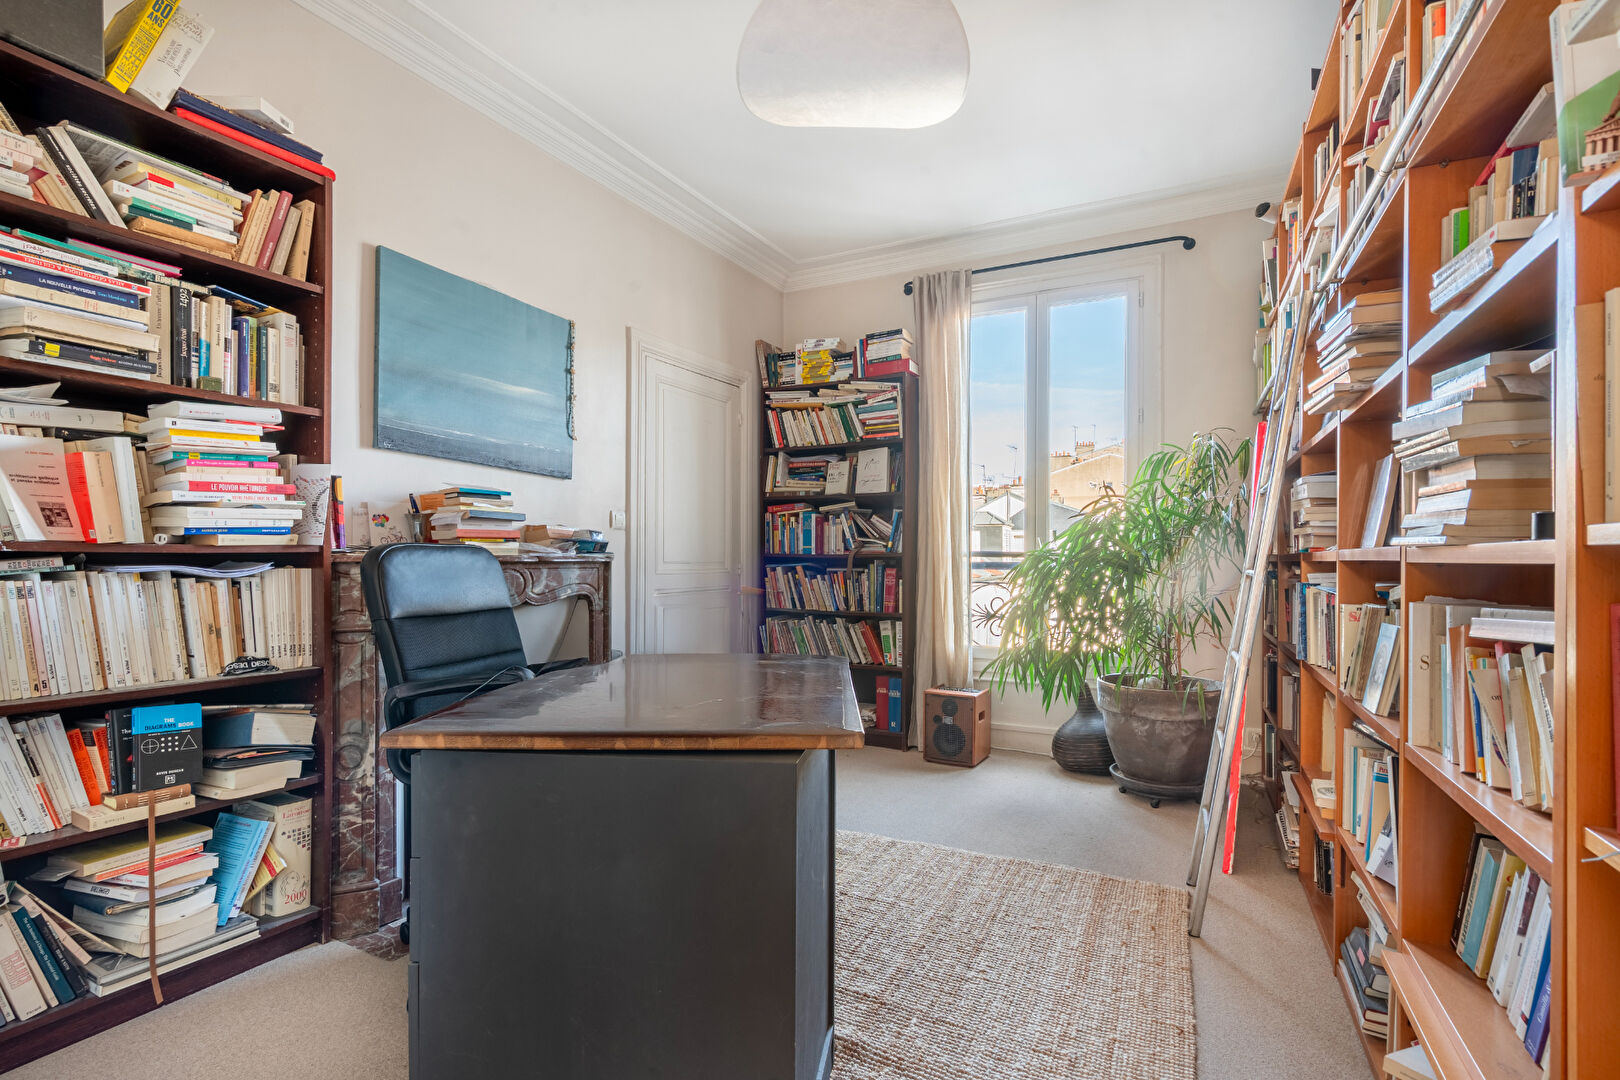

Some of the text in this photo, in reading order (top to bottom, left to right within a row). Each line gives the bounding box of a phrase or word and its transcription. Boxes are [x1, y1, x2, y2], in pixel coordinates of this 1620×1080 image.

[147, 11, 165, 28] ANS
[46, 280, 72, 289] NOUVELLE
[179, 288, 189, 307] 1492
[240, 484, 268, 492] RHÉTORIQUE
[144, 723, 176, 731] DIAGRAMS
[284, 889, 308, 905] 2000
